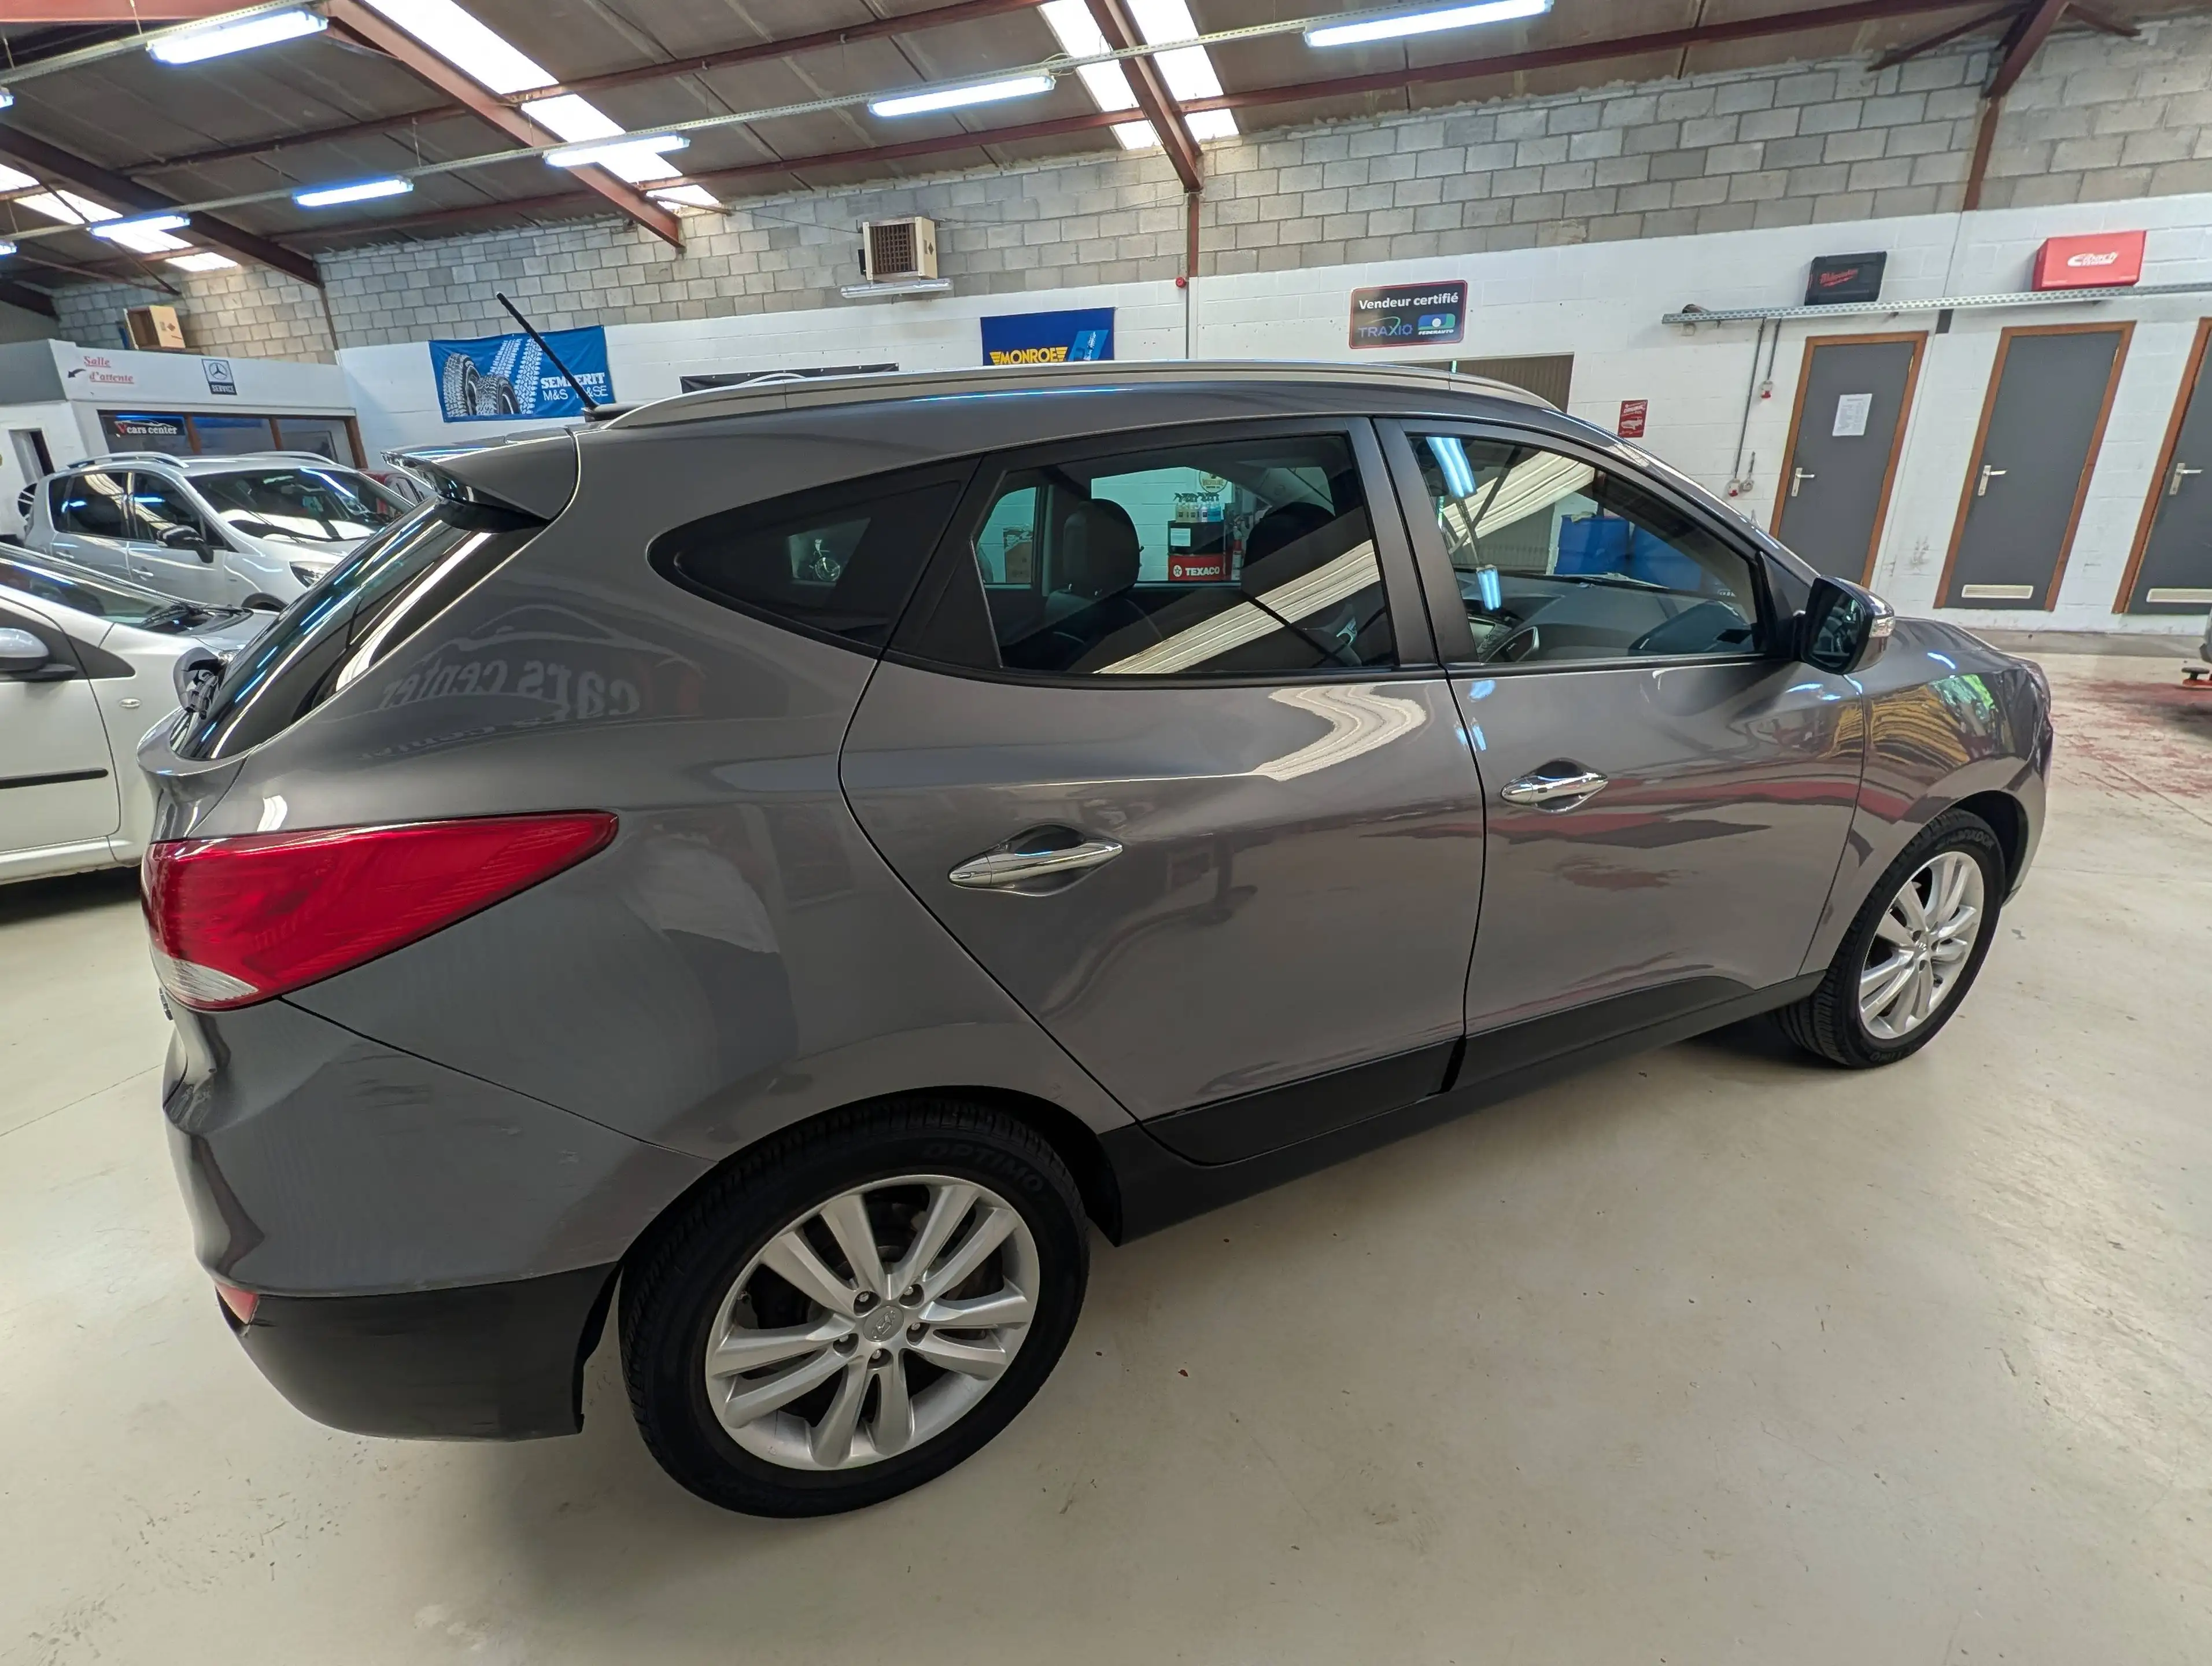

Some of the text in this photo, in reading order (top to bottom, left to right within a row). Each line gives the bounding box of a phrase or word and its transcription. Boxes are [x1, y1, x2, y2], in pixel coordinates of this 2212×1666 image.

[1359, 292, 1458, 309] Vendeur certifié
[1358, 324, 1413, 338] TRAXIO
[83, 356, 110, 367] Salle
[1000, 347, 1058, 365] MONROE
[89, 371, 134, 382] d'attente
[540, 373, 605, 389] SEMERIT
[542, 388, 568, 400] M&S
[1185, 567, 1220, 576] TEXACO
